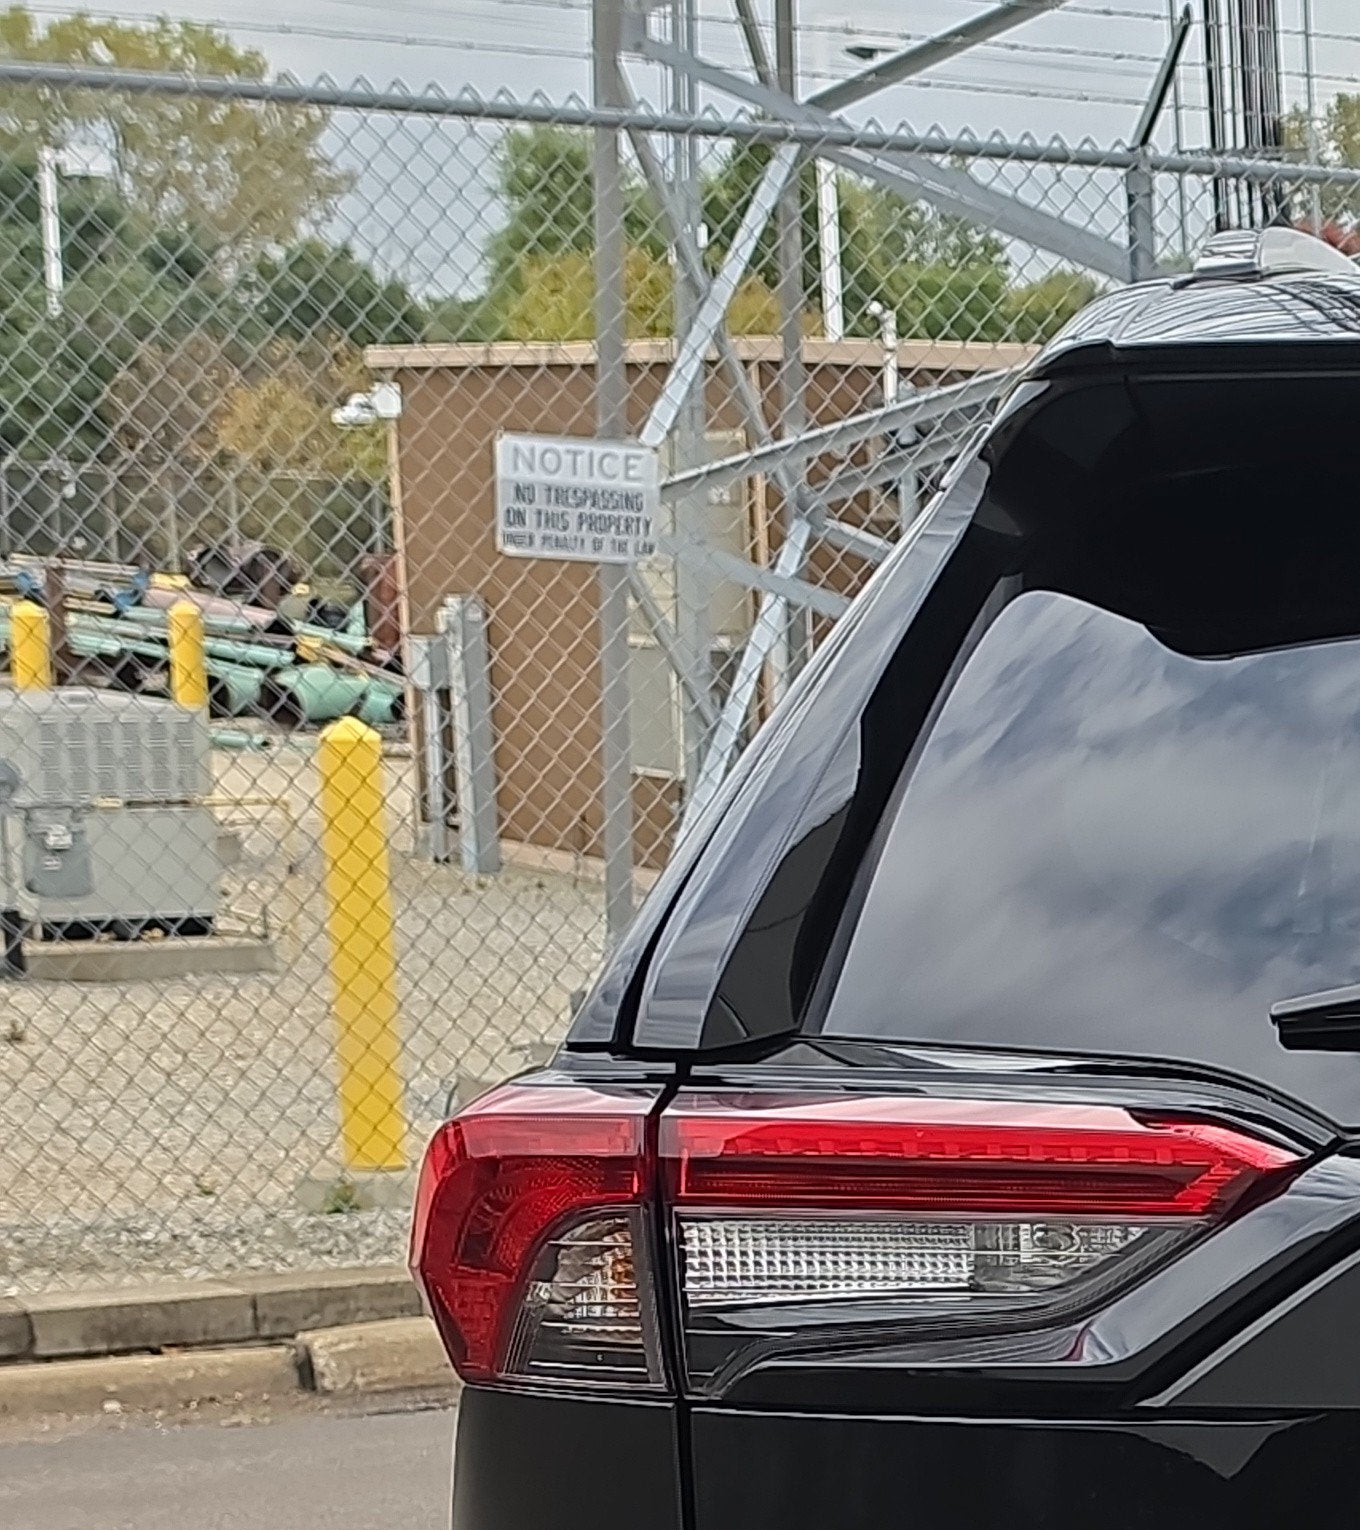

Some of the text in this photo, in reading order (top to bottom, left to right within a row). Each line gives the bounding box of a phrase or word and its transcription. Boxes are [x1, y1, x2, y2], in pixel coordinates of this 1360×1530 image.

[513, 443, 645, 480] NOTICE
[514, 482, 644, 512] NO TRESPASSING
[505, 506, 653, 537] ON THIS PROPERTY
